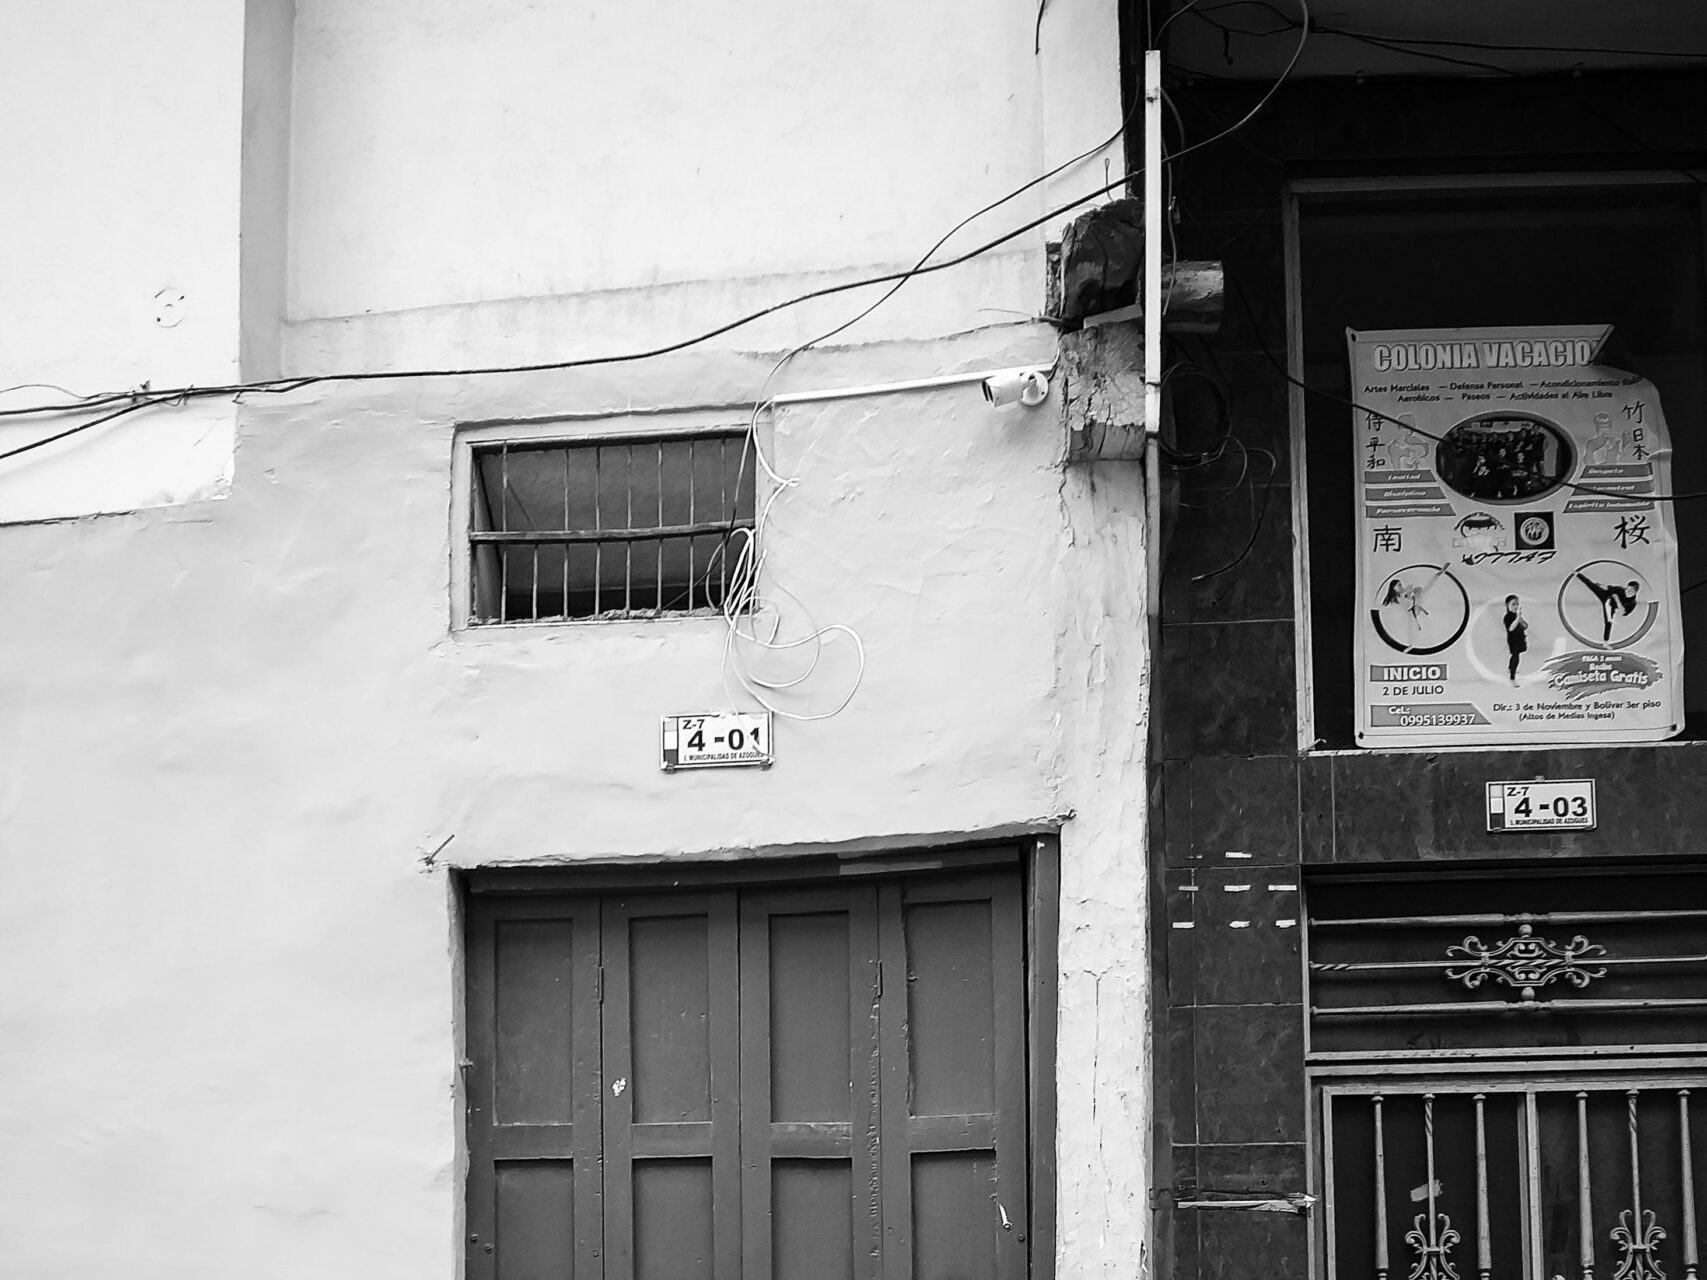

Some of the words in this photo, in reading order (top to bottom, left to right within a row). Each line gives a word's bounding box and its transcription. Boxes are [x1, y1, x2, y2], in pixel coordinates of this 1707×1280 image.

[1373, 343, 1480, 372] COLONIA
[1482, 340, 1598, 368] VACACIO
[1364, 385, 1387, 393] Artes
[1390, 384, 1430, 392] Marciales
[1450, 382, 1484, 390] Defensa
[1487, 381, 1524, 389] Personal
[1462, 392, 1491, 400] Paseos
[1510, 391, 1559, 400] Actividades
[1572, 391, 1589, 399] Aire
[1592, 390, 1613, 399] Libre
[1613, 515, 1651, 549] 桜
[1373, 524, 1403, 553] 南
[1383, 666, 1441, 680] INICIO
[1554, 670, 1607, 686] Camiseta
[1610, 670, 1649, 685] Gratis
[1382, 686, 1390, 696] 2
[1393, 686, 1409, 695] DE
[1411, 685, 1444, 695] JULIO
[1515, 703, 1521, 711] 3
[1537, 702, 1583, 710] Noviembre
[1585, 703, 1592, 712] y
[1625, 701, 1640, 709] 3er
[1642, 699, 1662, 710] piso
[1400, 714, 1476, 726] 0995139937
[1546, 712, 1555, 720] de
[683, 719, 705, 730] Z-7
[689, 753, 729, 761] MUNICIPALIDAD
[1507, 786, 1530, 797] Z-7
